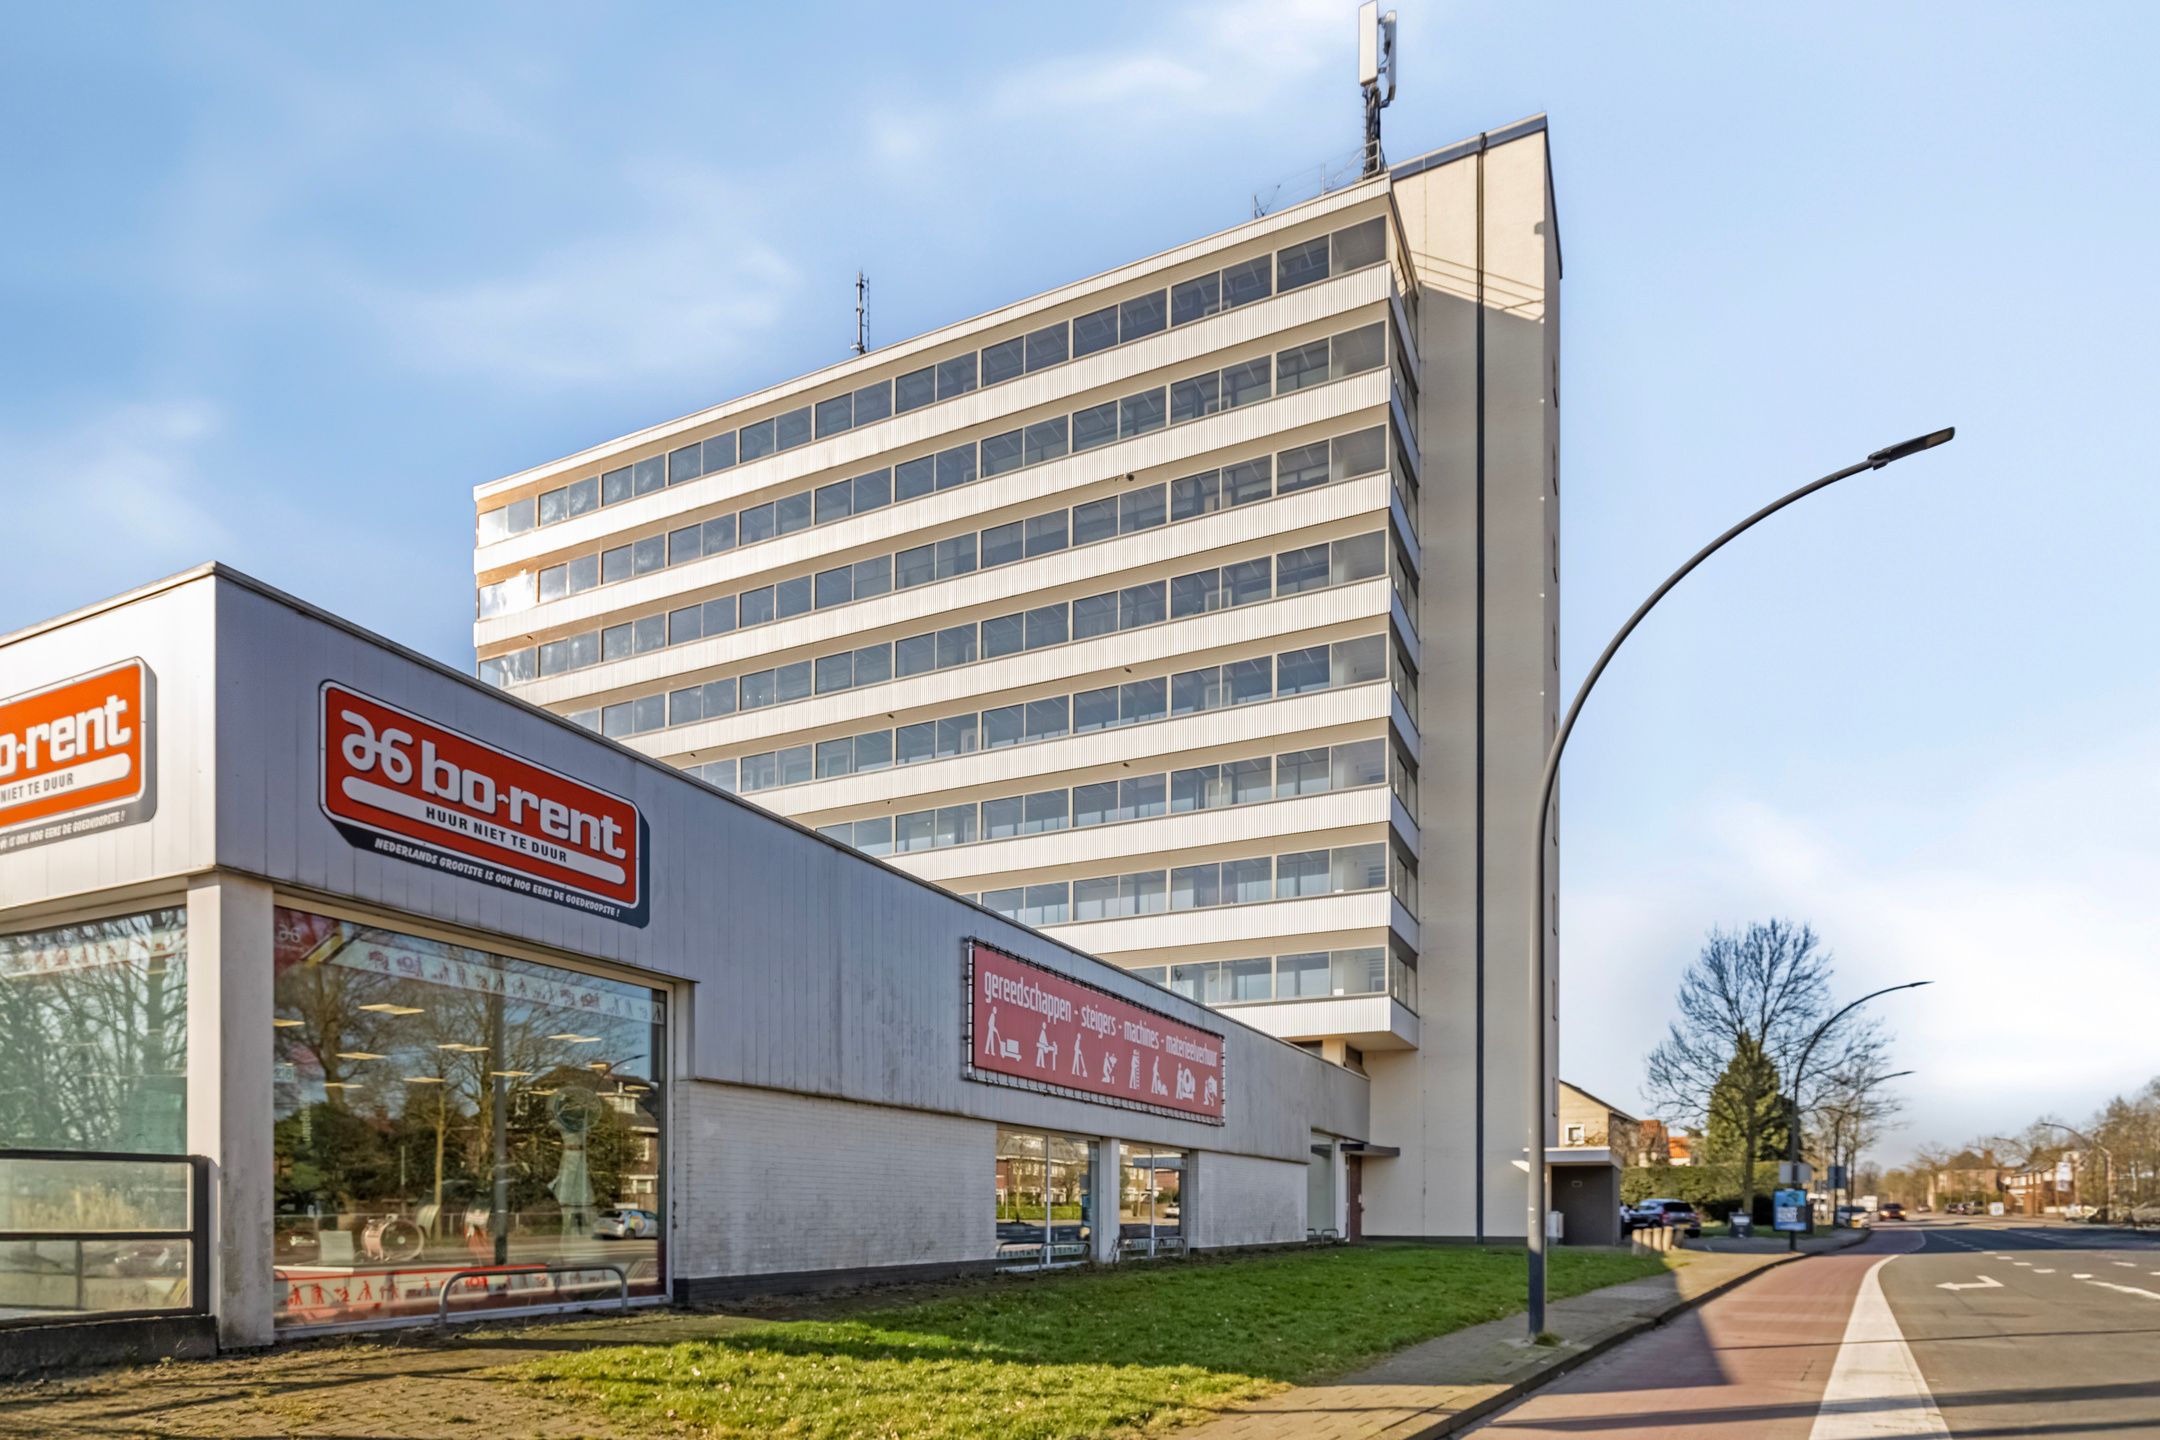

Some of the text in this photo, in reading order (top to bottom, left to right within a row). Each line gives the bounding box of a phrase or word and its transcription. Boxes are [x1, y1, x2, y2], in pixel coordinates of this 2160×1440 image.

[0, 773, 74, 802] NIET TE DUUR
[426, 806, 567, 862] HUUR NIET TE DUUR
[375, 837, 437, 865] NEDERLANDS
[439, 856, 483, 878] GROOTSTE
[485, 870, 494, 881] IS
[495, 873, 512, 886] OOK
[514, 879, 531, 891] NOG
[533, 884, 553, 898] EENS
[554, 890, 564, 902] DE
[566, 894, 615, 916] GOEDKOOPSTE
[984, 971, 1072, 1025] gereedschappen
[1081, 1004, 1117, 1039] steigers
[1124, 1019, 1160, 1050] machines
